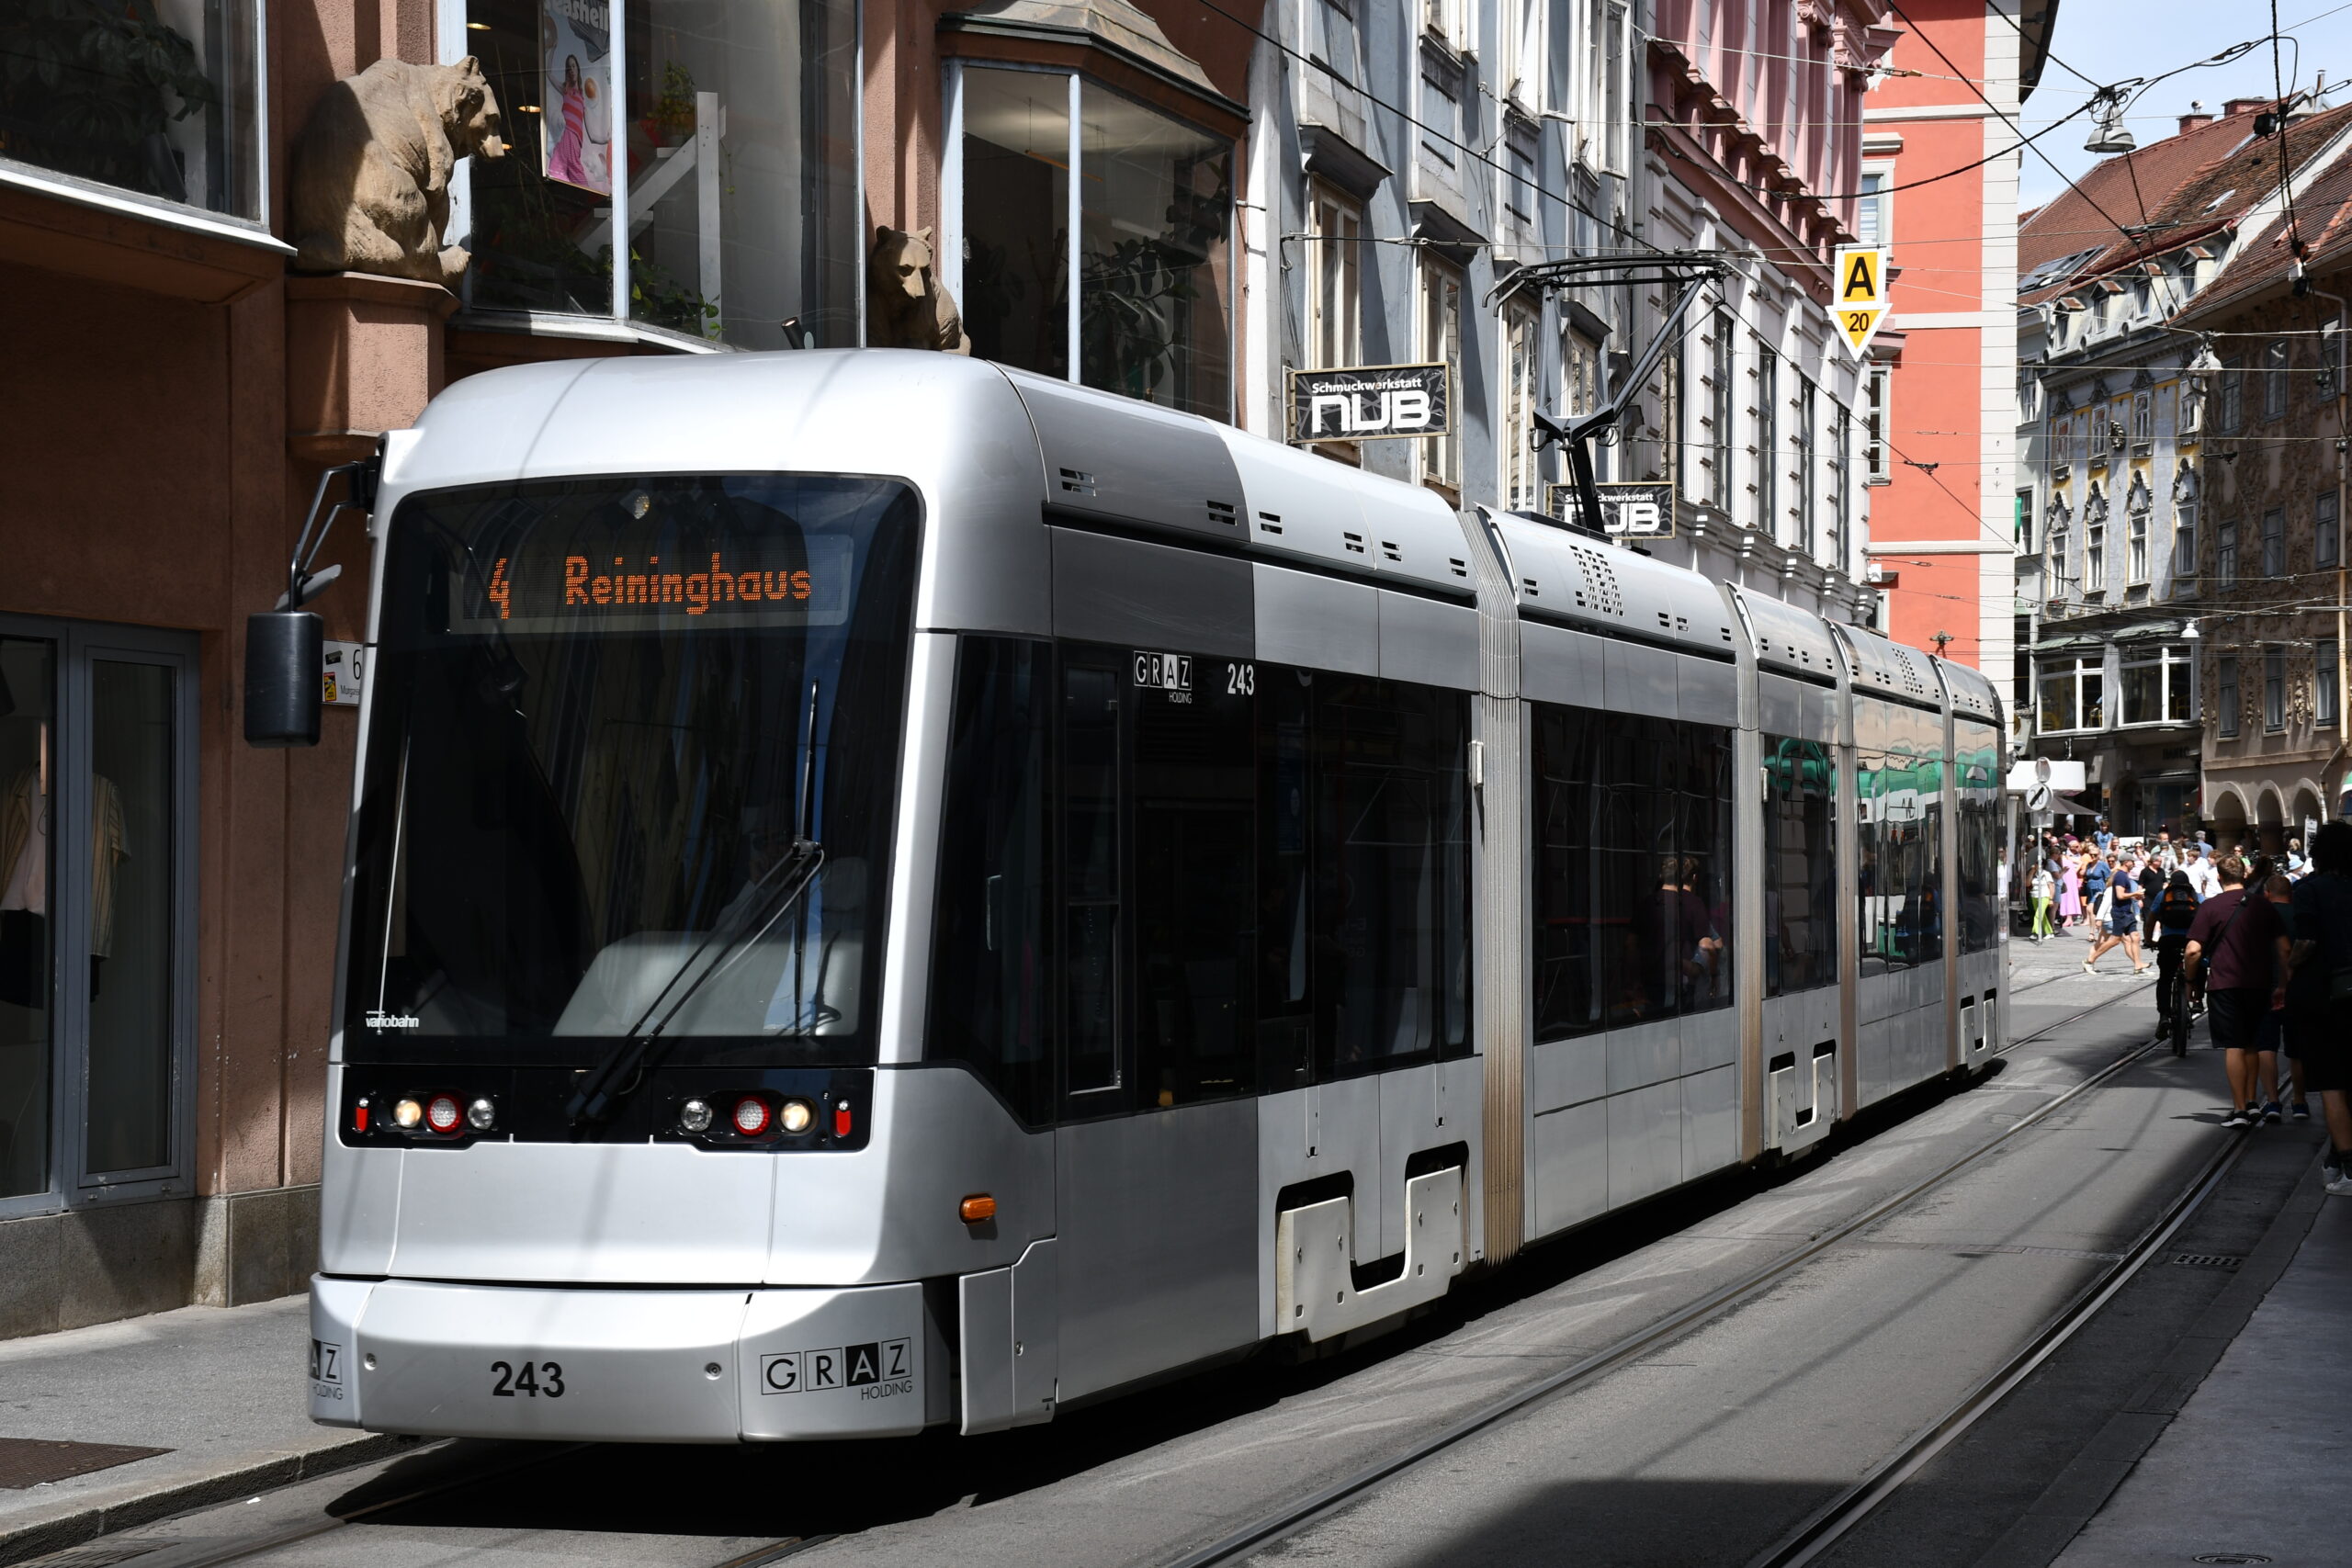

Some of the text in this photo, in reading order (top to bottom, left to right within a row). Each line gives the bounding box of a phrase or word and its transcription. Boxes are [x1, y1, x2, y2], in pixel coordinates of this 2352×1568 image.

[1844, 256, 1874, 297] A
[1849, 312, 1869, 332] 20
[1312, 378, 1422, 393] Schmuckwerkstatt
[489, 551, 811, 619] 4 Reininghaus
[353, 649, 362, 680] 6
[1135, 655, 1191, 687] GRAZ
[1227, 662, 1254, 696] 243
[1169, 691, 1192, 705] HOLDING
[491, 1360, 565, 1398] 243
[765, 1343, 907, 1390] GRAZ
[861, 1380, 913, 1401] HOLDING
